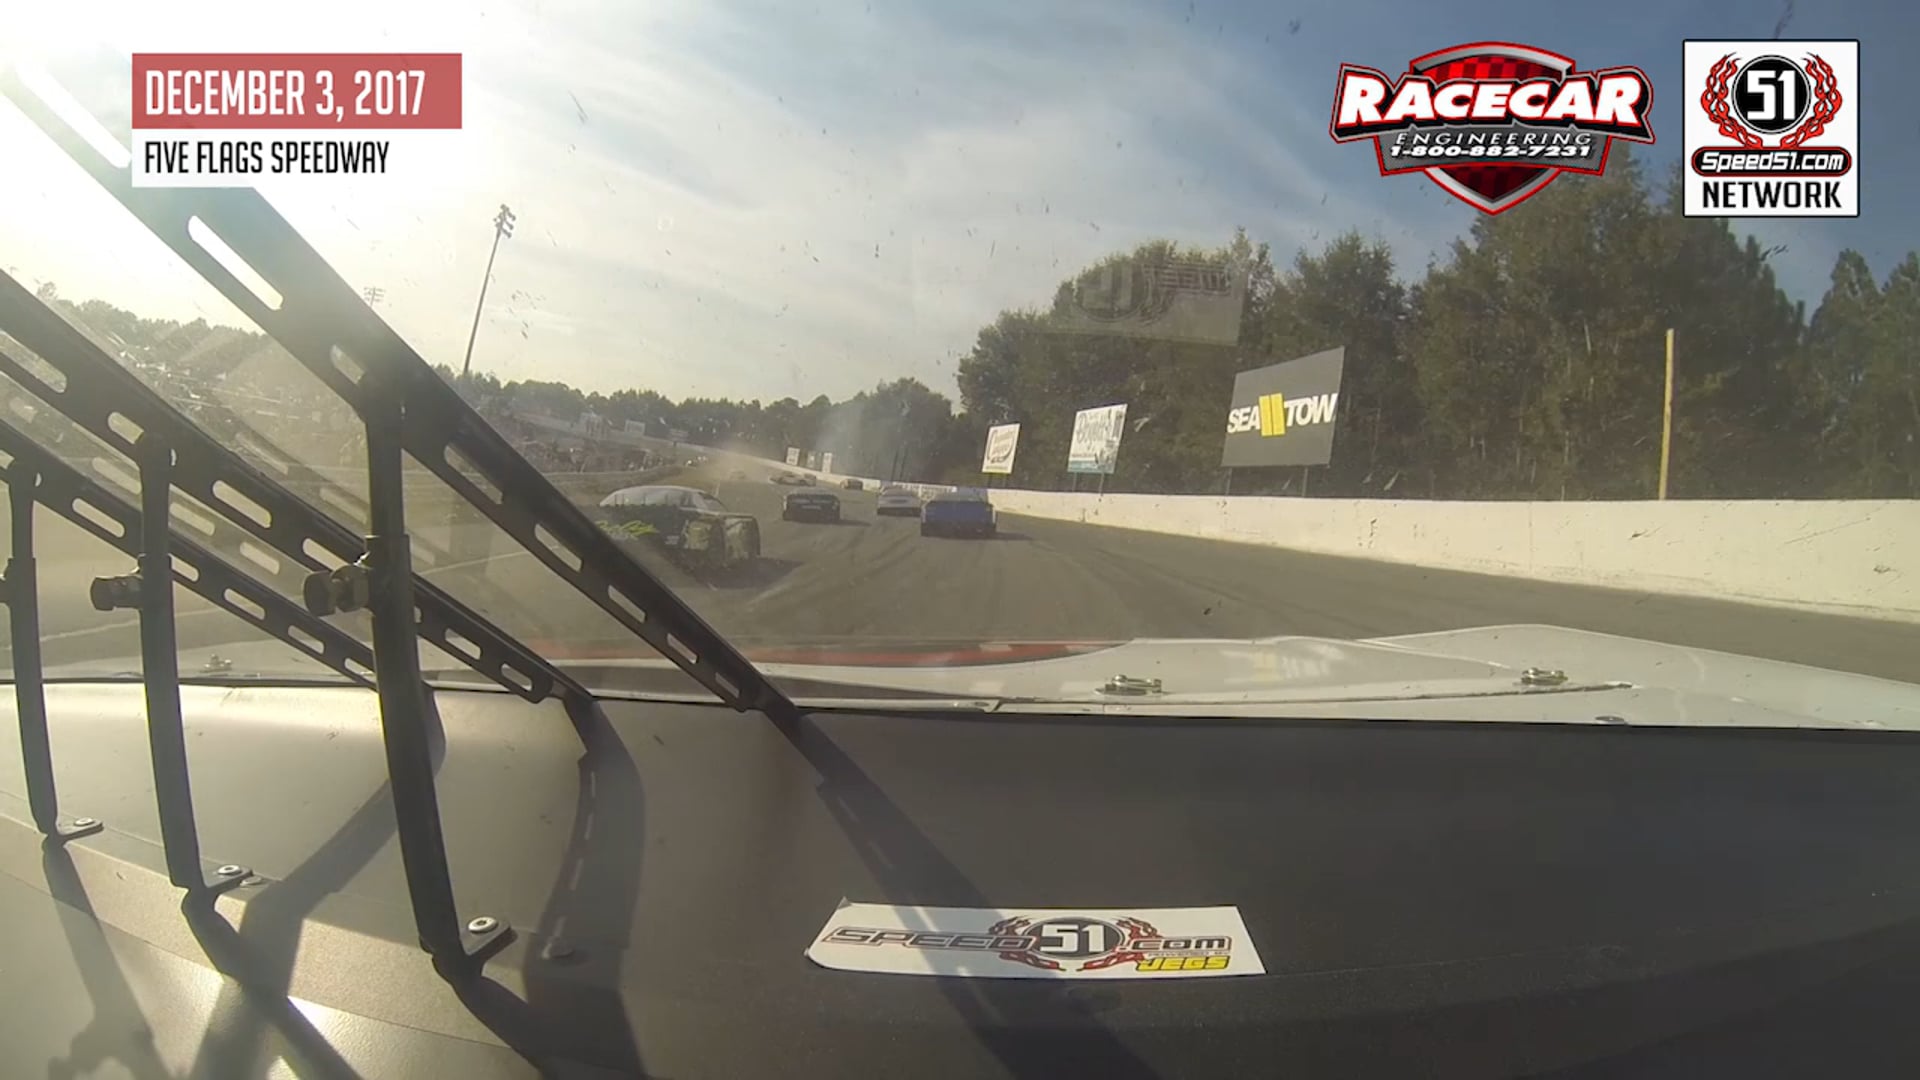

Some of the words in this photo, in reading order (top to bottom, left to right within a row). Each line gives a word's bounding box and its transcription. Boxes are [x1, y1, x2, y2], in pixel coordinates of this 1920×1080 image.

[1226, 404, 1261, 433] SEA
[1284, 393, 1338, 427] TOW
[1136, 955, 1231, 971] JEGS
